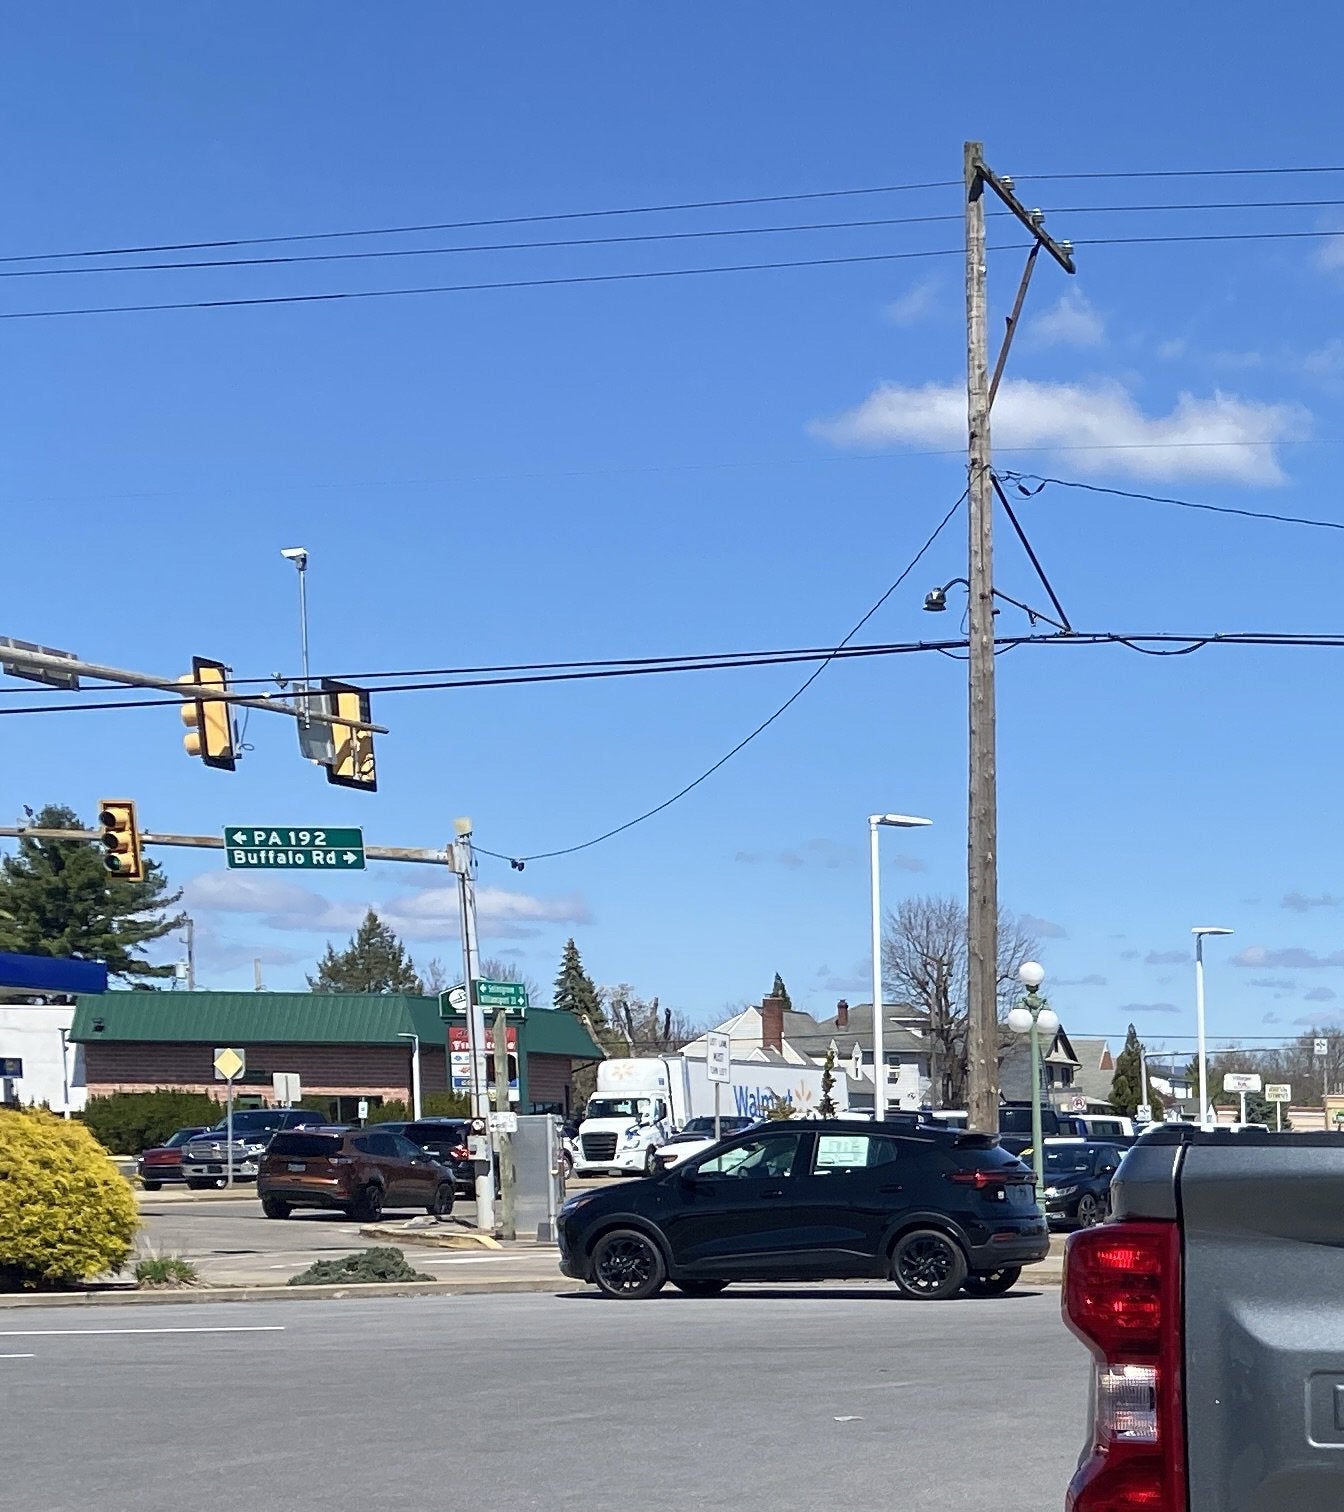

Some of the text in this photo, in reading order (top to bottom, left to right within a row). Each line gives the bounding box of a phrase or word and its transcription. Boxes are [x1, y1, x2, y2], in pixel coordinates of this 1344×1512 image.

[253, 830, 327, 846] PA 192
[233, 850, 336, 865] Buffalo Rd
